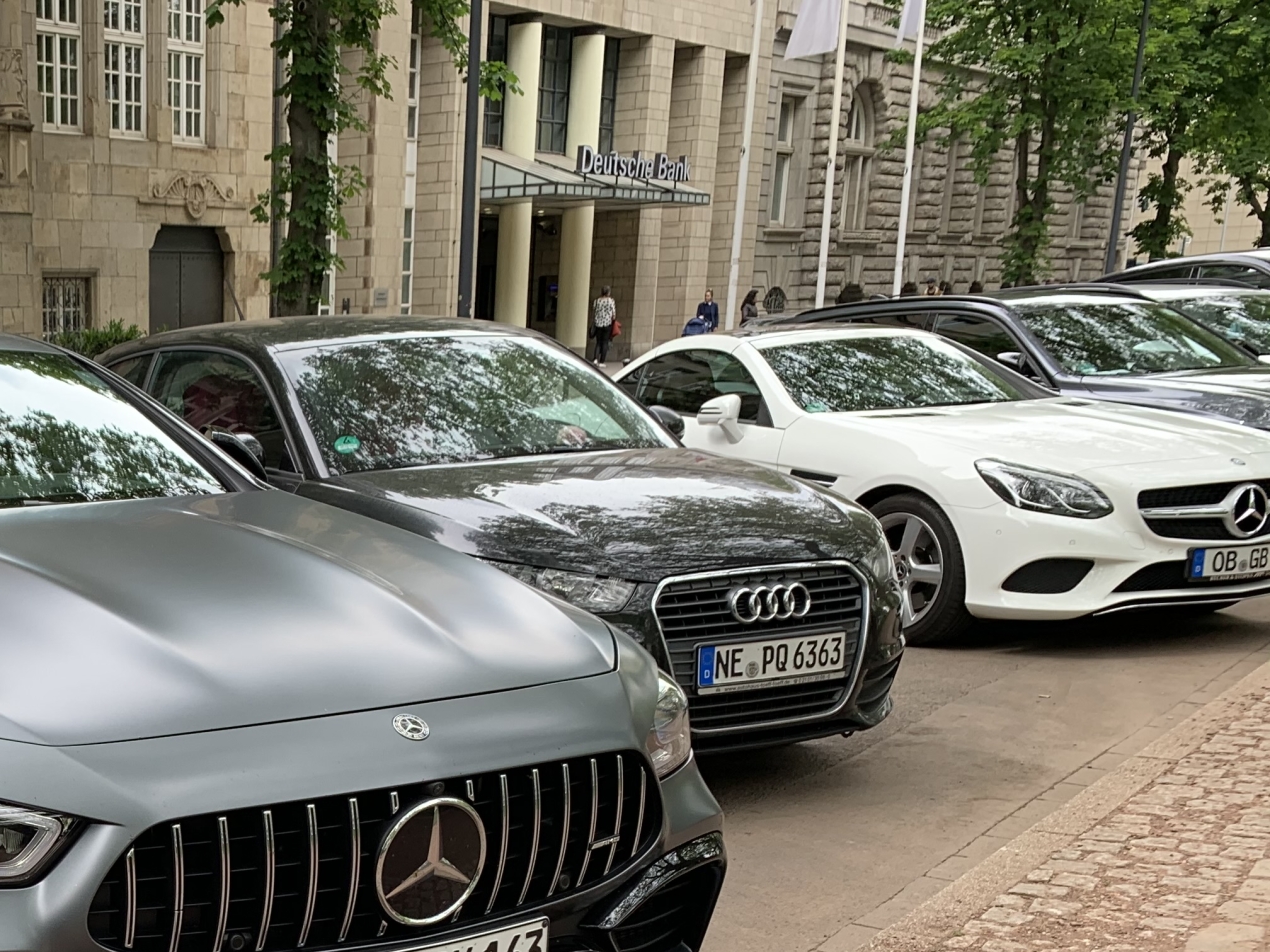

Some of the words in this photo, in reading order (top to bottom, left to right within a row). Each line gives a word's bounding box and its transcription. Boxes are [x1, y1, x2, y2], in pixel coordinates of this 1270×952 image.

[580, 145, 654, 180] Deutsche
[657, 153, 691, 182] Bank
[1212, 550, 1238, 573] OB
[1249, 547, 1269, 569] GB
[715, 648, 744, 679] NE
[762, 643, 789, 675] PQ
[793, 637, 842, 670] 6363
[704, 669, 711, 679] D
